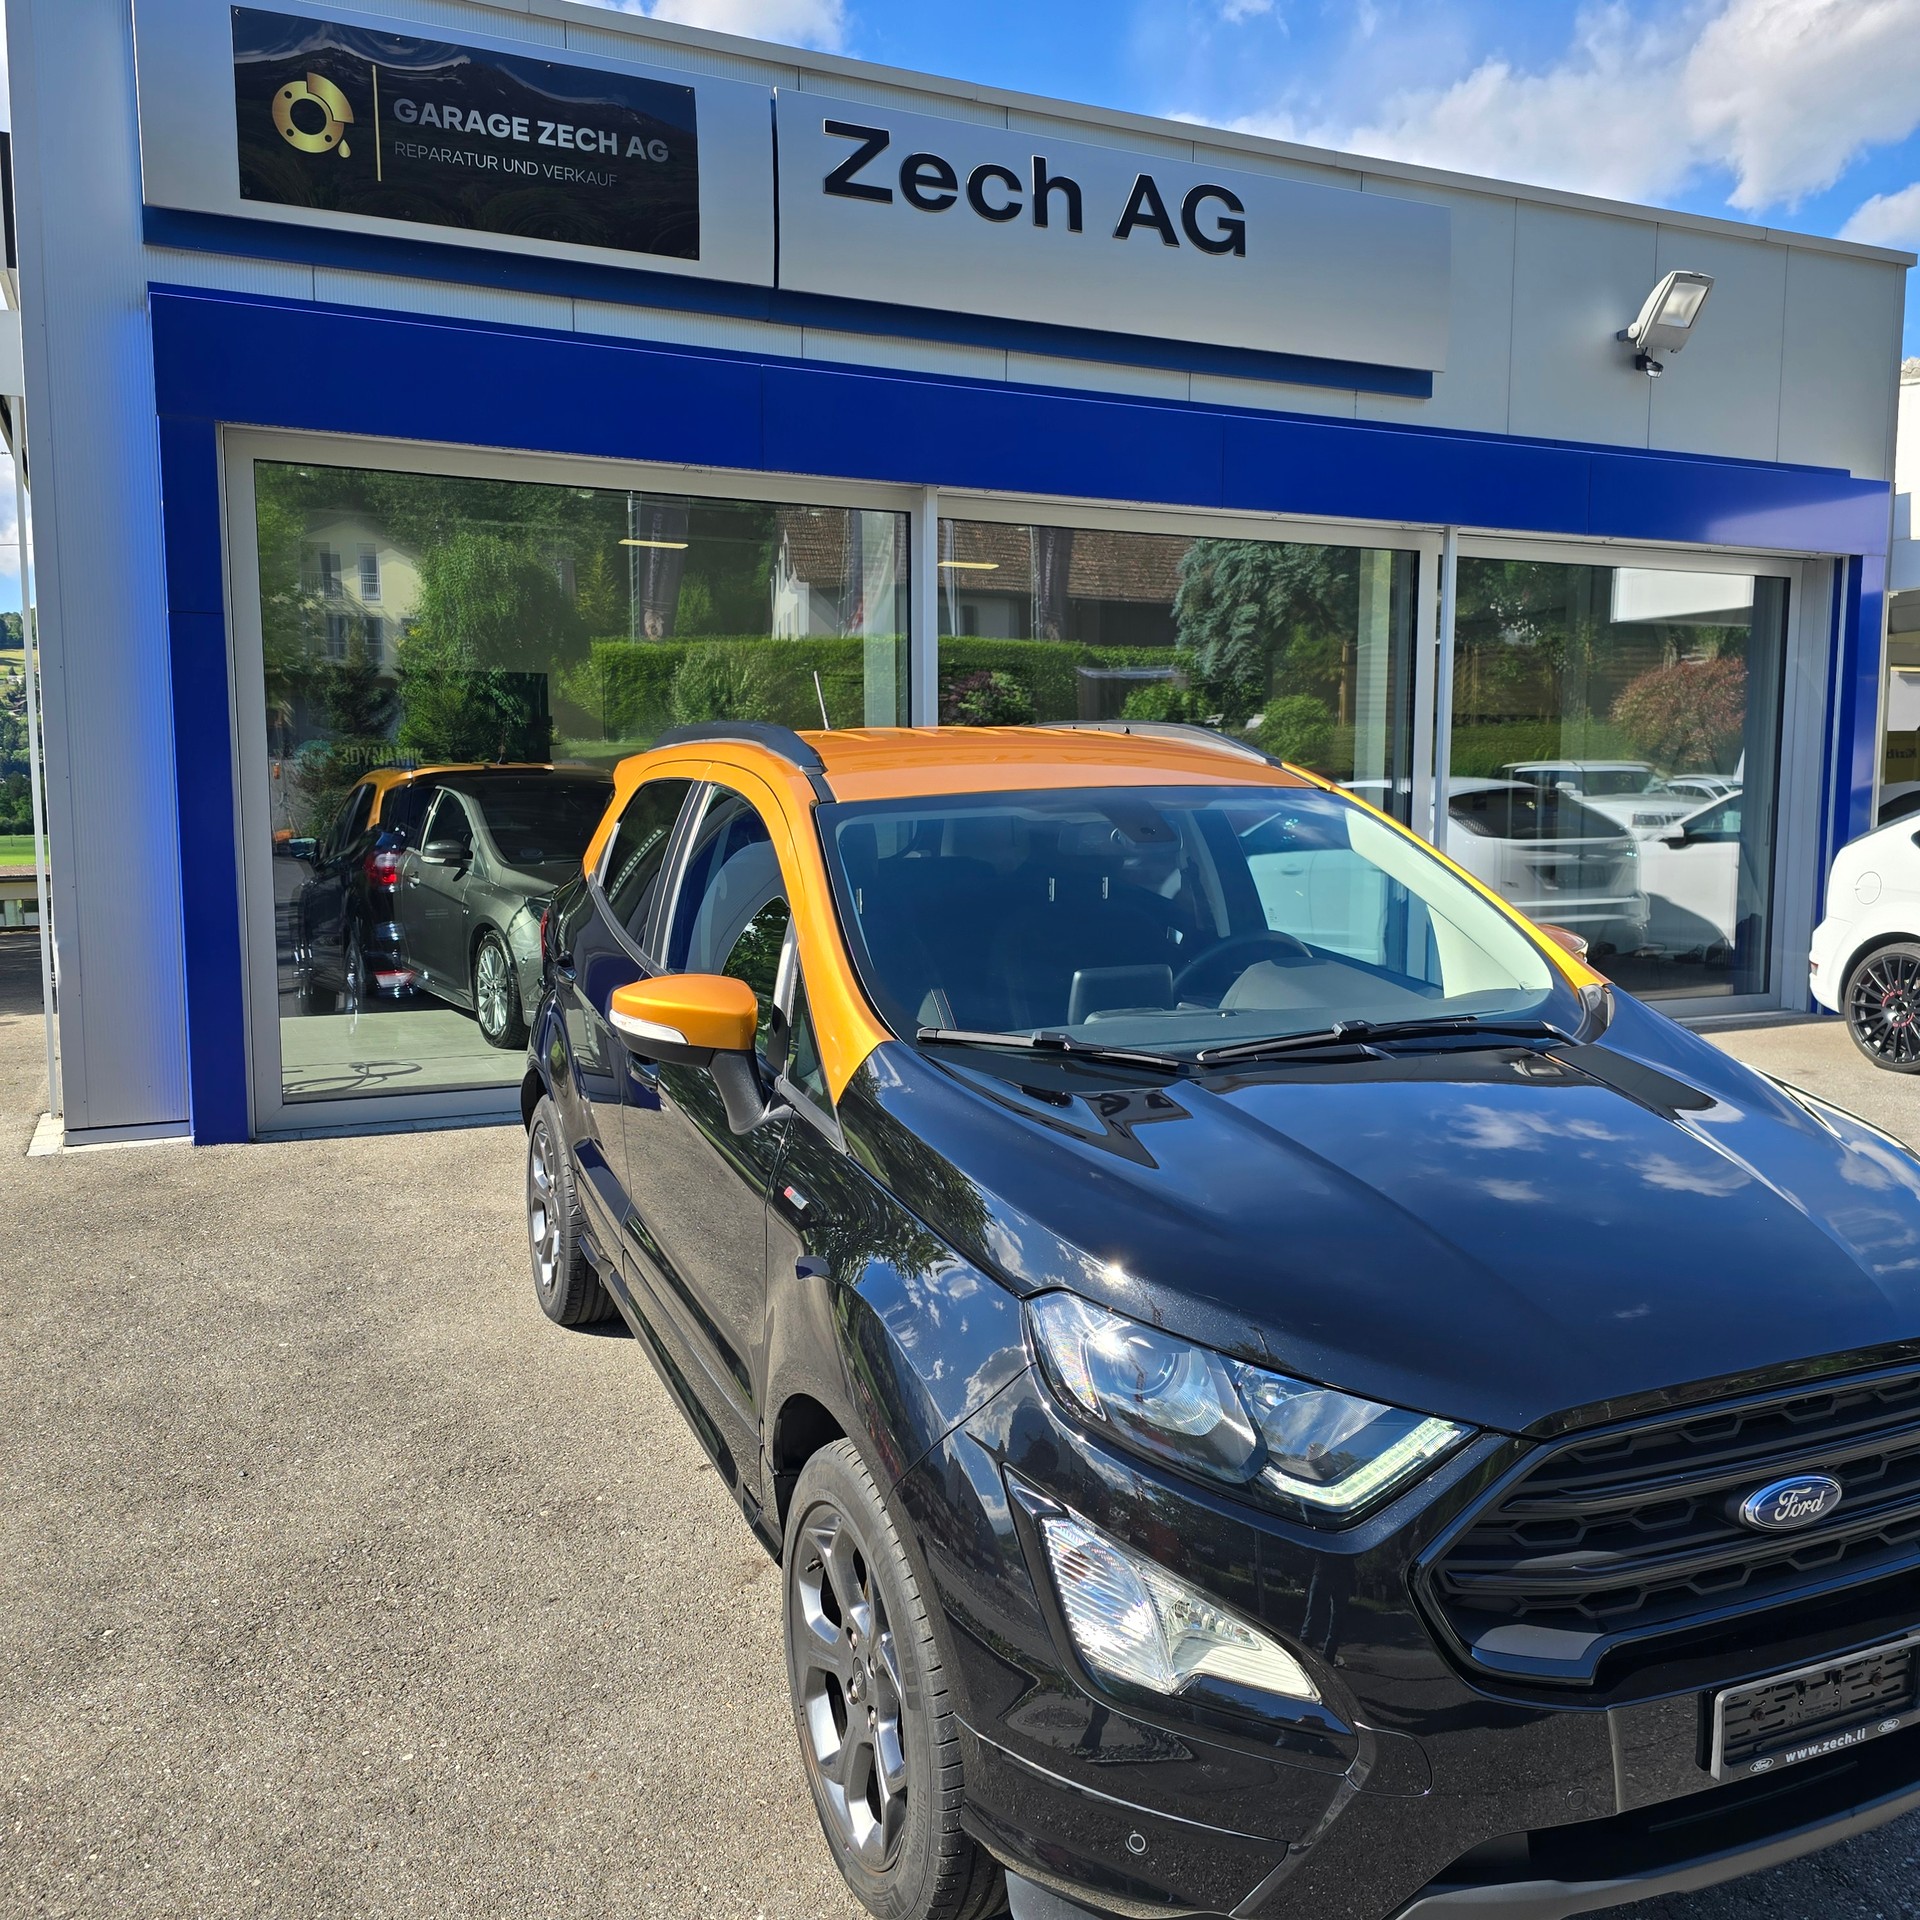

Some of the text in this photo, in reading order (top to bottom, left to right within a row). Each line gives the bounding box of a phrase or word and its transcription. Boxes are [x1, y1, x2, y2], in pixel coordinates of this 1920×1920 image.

[393, 98, 669, 163] GARAGE ZECH AG
[394, 141, 618, 187] REPARATUR UND VERKAUF
[821, 117, 1247, 258] Zech AG
[1774, 1487, 1825, 1522] Ford
[1785, 1727, 1866, 1763] www.zech.li
